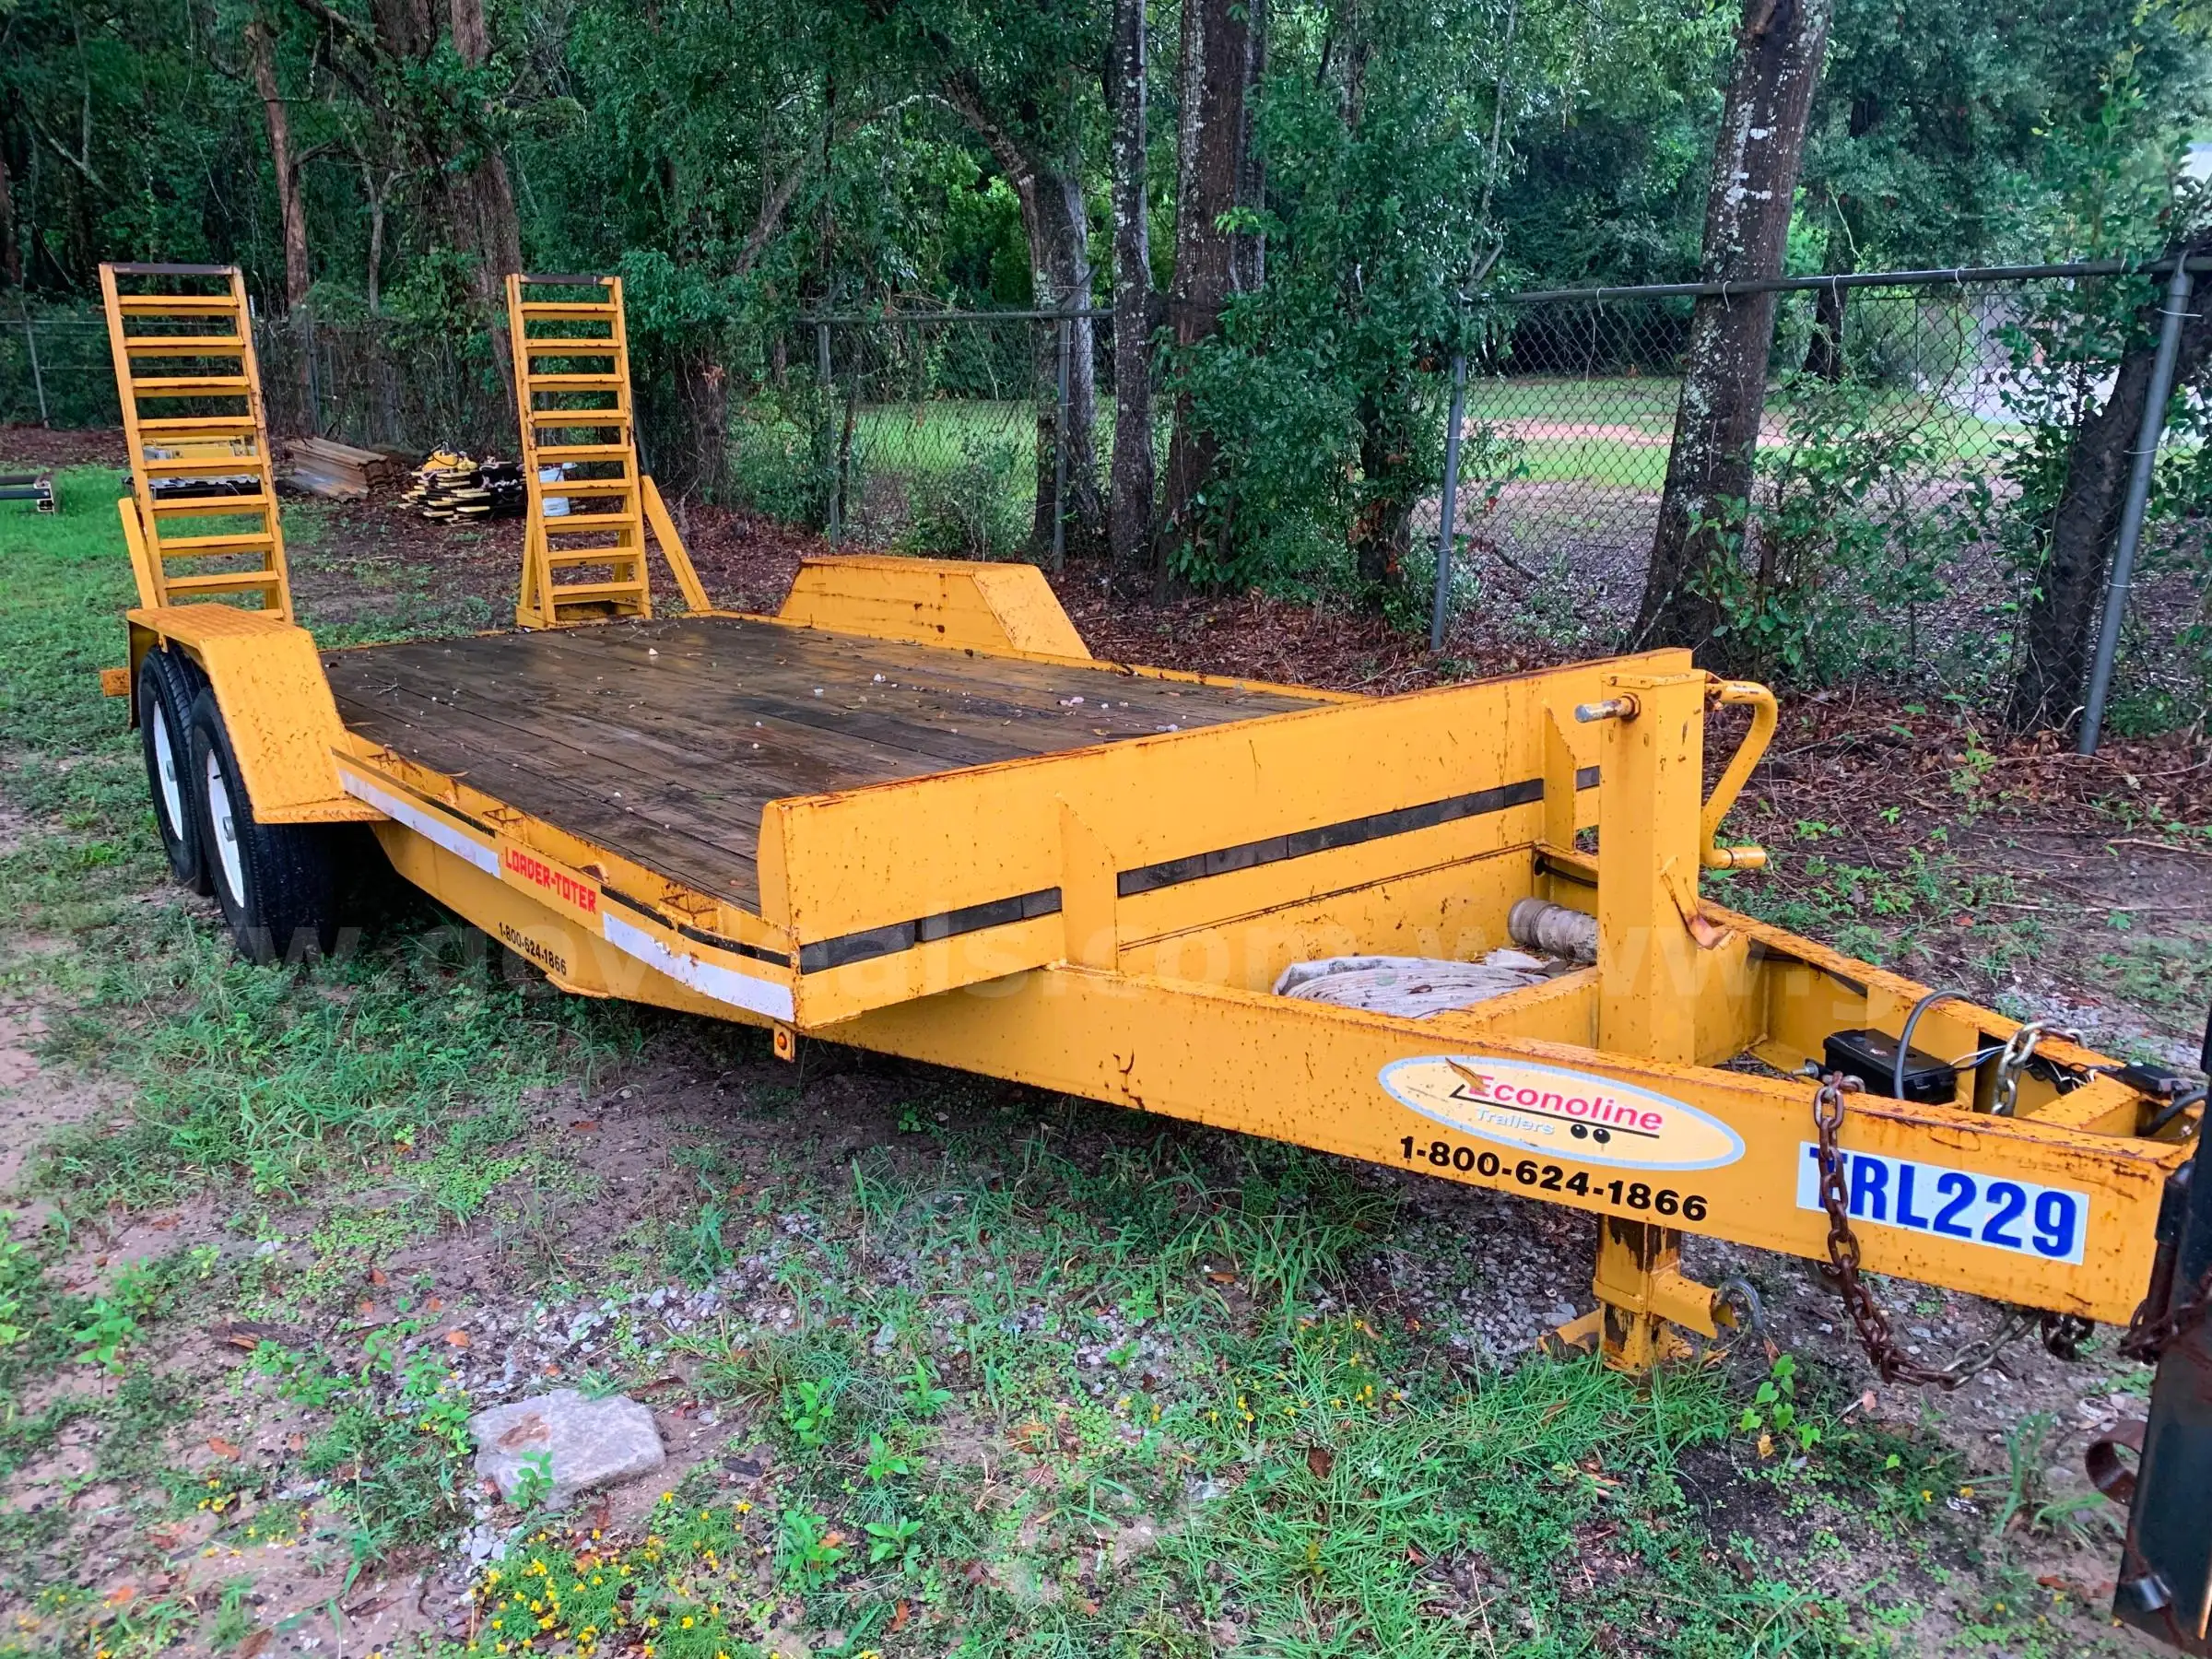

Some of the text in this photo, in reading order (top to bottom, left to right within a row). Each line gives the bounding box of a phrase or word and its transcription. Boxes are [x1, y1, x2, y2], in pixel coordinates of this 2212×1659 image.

[505, 846, 597, 914] LOADER-TOTER
[499, 922, 567, 976] 1-800-624-1866
[1468, 1074, 1664, 1131] Econoline
[1476, 1107, 1556, 1135] Trailers
[1399, 1135, 1709, 1222] 1-800-624-1866
